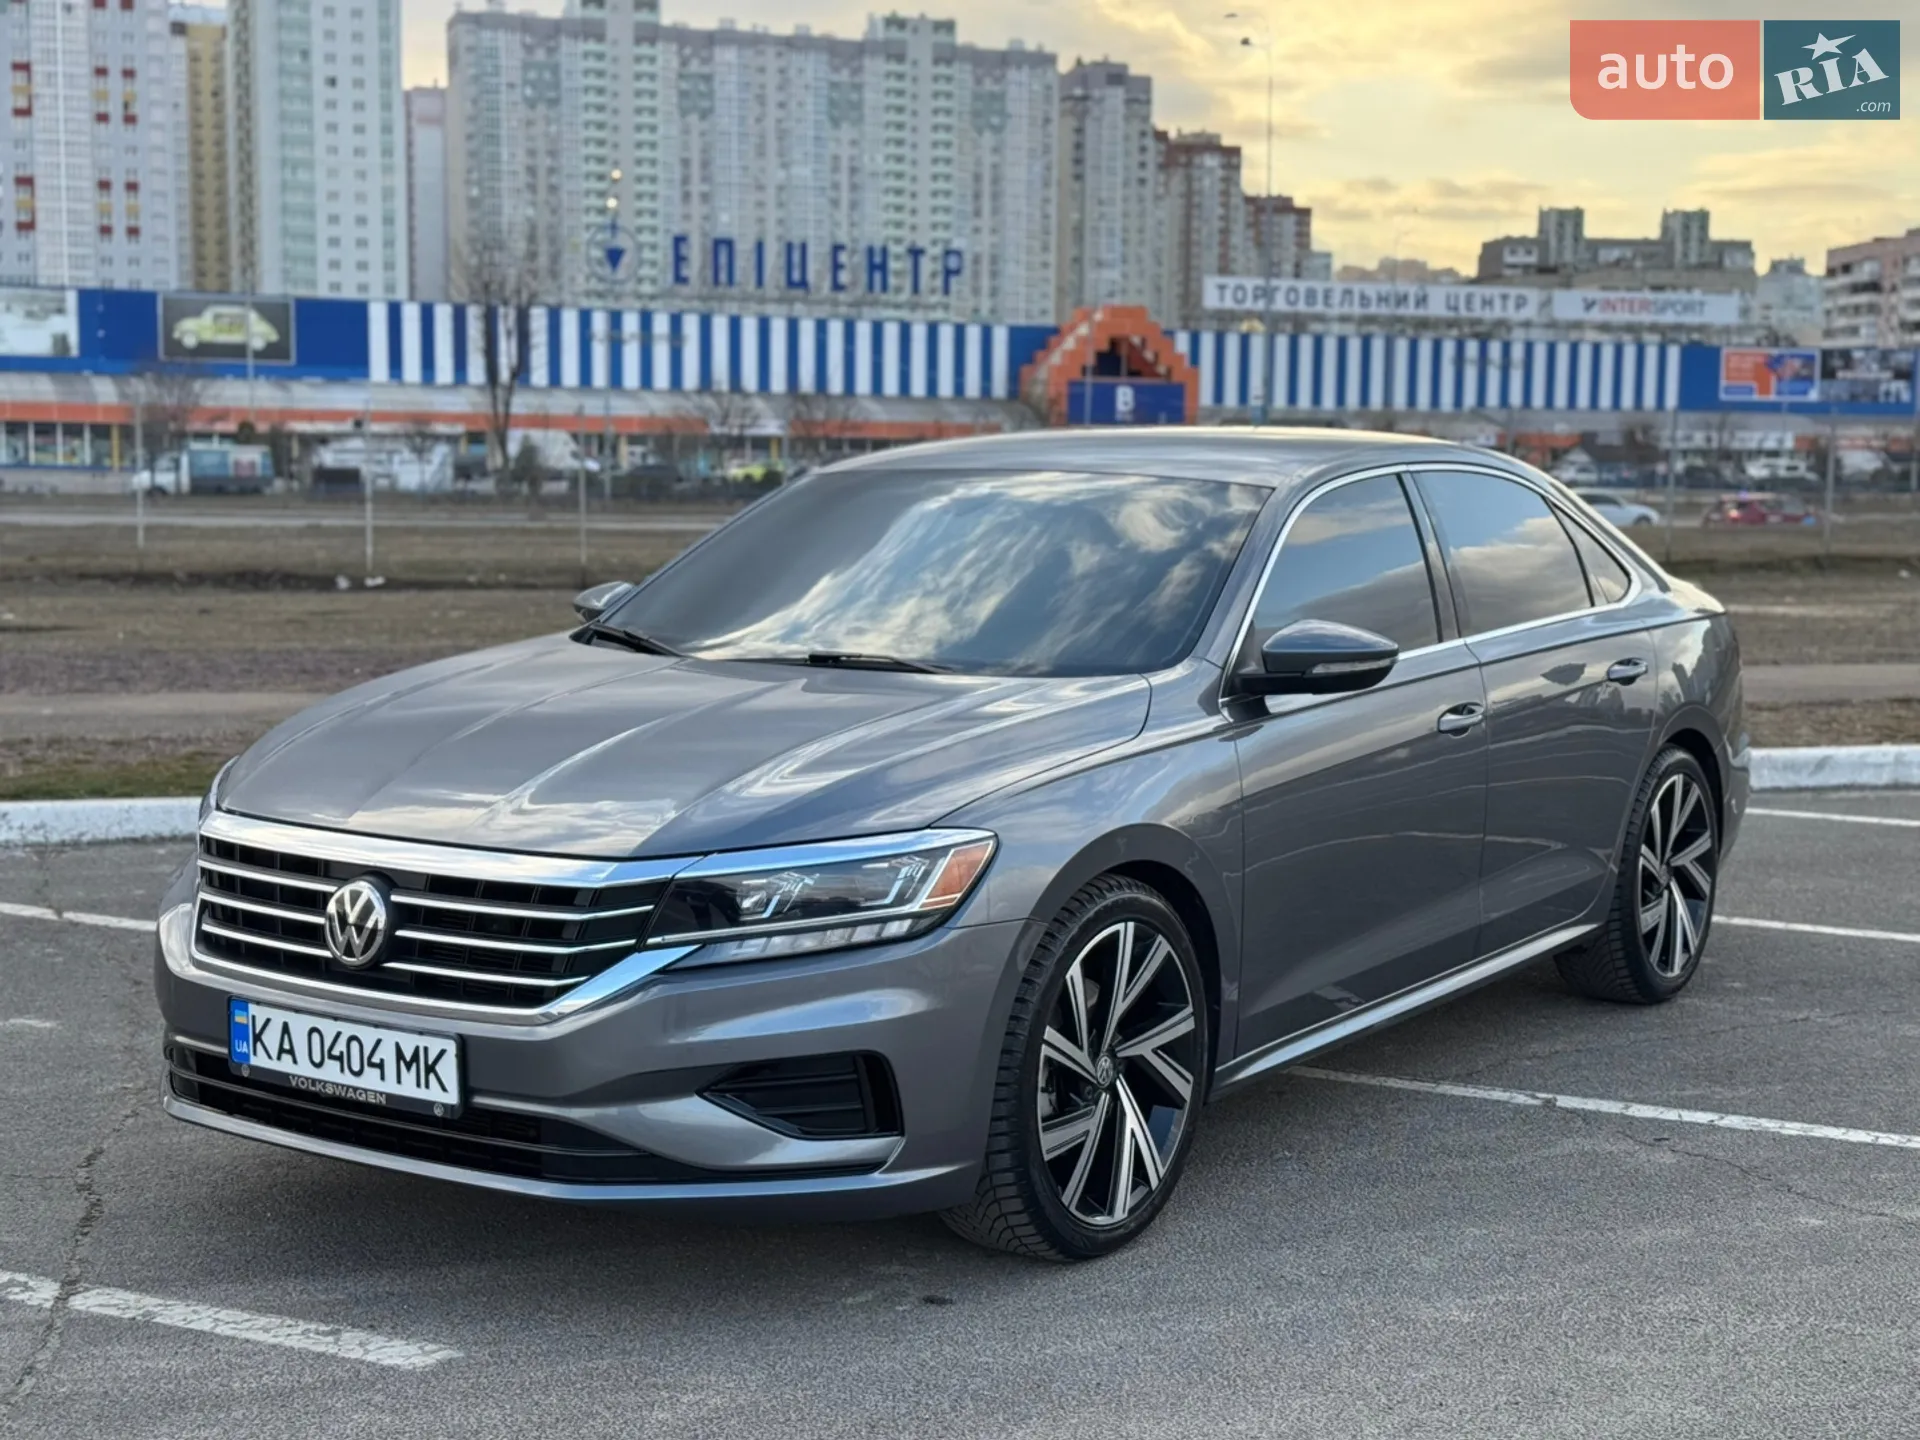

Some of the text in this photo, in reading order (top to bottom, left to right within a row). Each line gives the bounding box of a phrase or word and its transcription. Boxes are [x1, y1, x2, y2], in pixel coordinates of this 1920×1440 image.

[672, 235, 964, 296] ЕПІЦЕНТР
[1215, 283, 1529, 316] ТОРГОВЕЛЬНИЙ ЦЕНТР
[235, 1039, 249, 1054] UA
[251, 1014, 449, 1093] KA 0404 MK
[288, 1075, 387, 1105] VOLKSWAGEN
